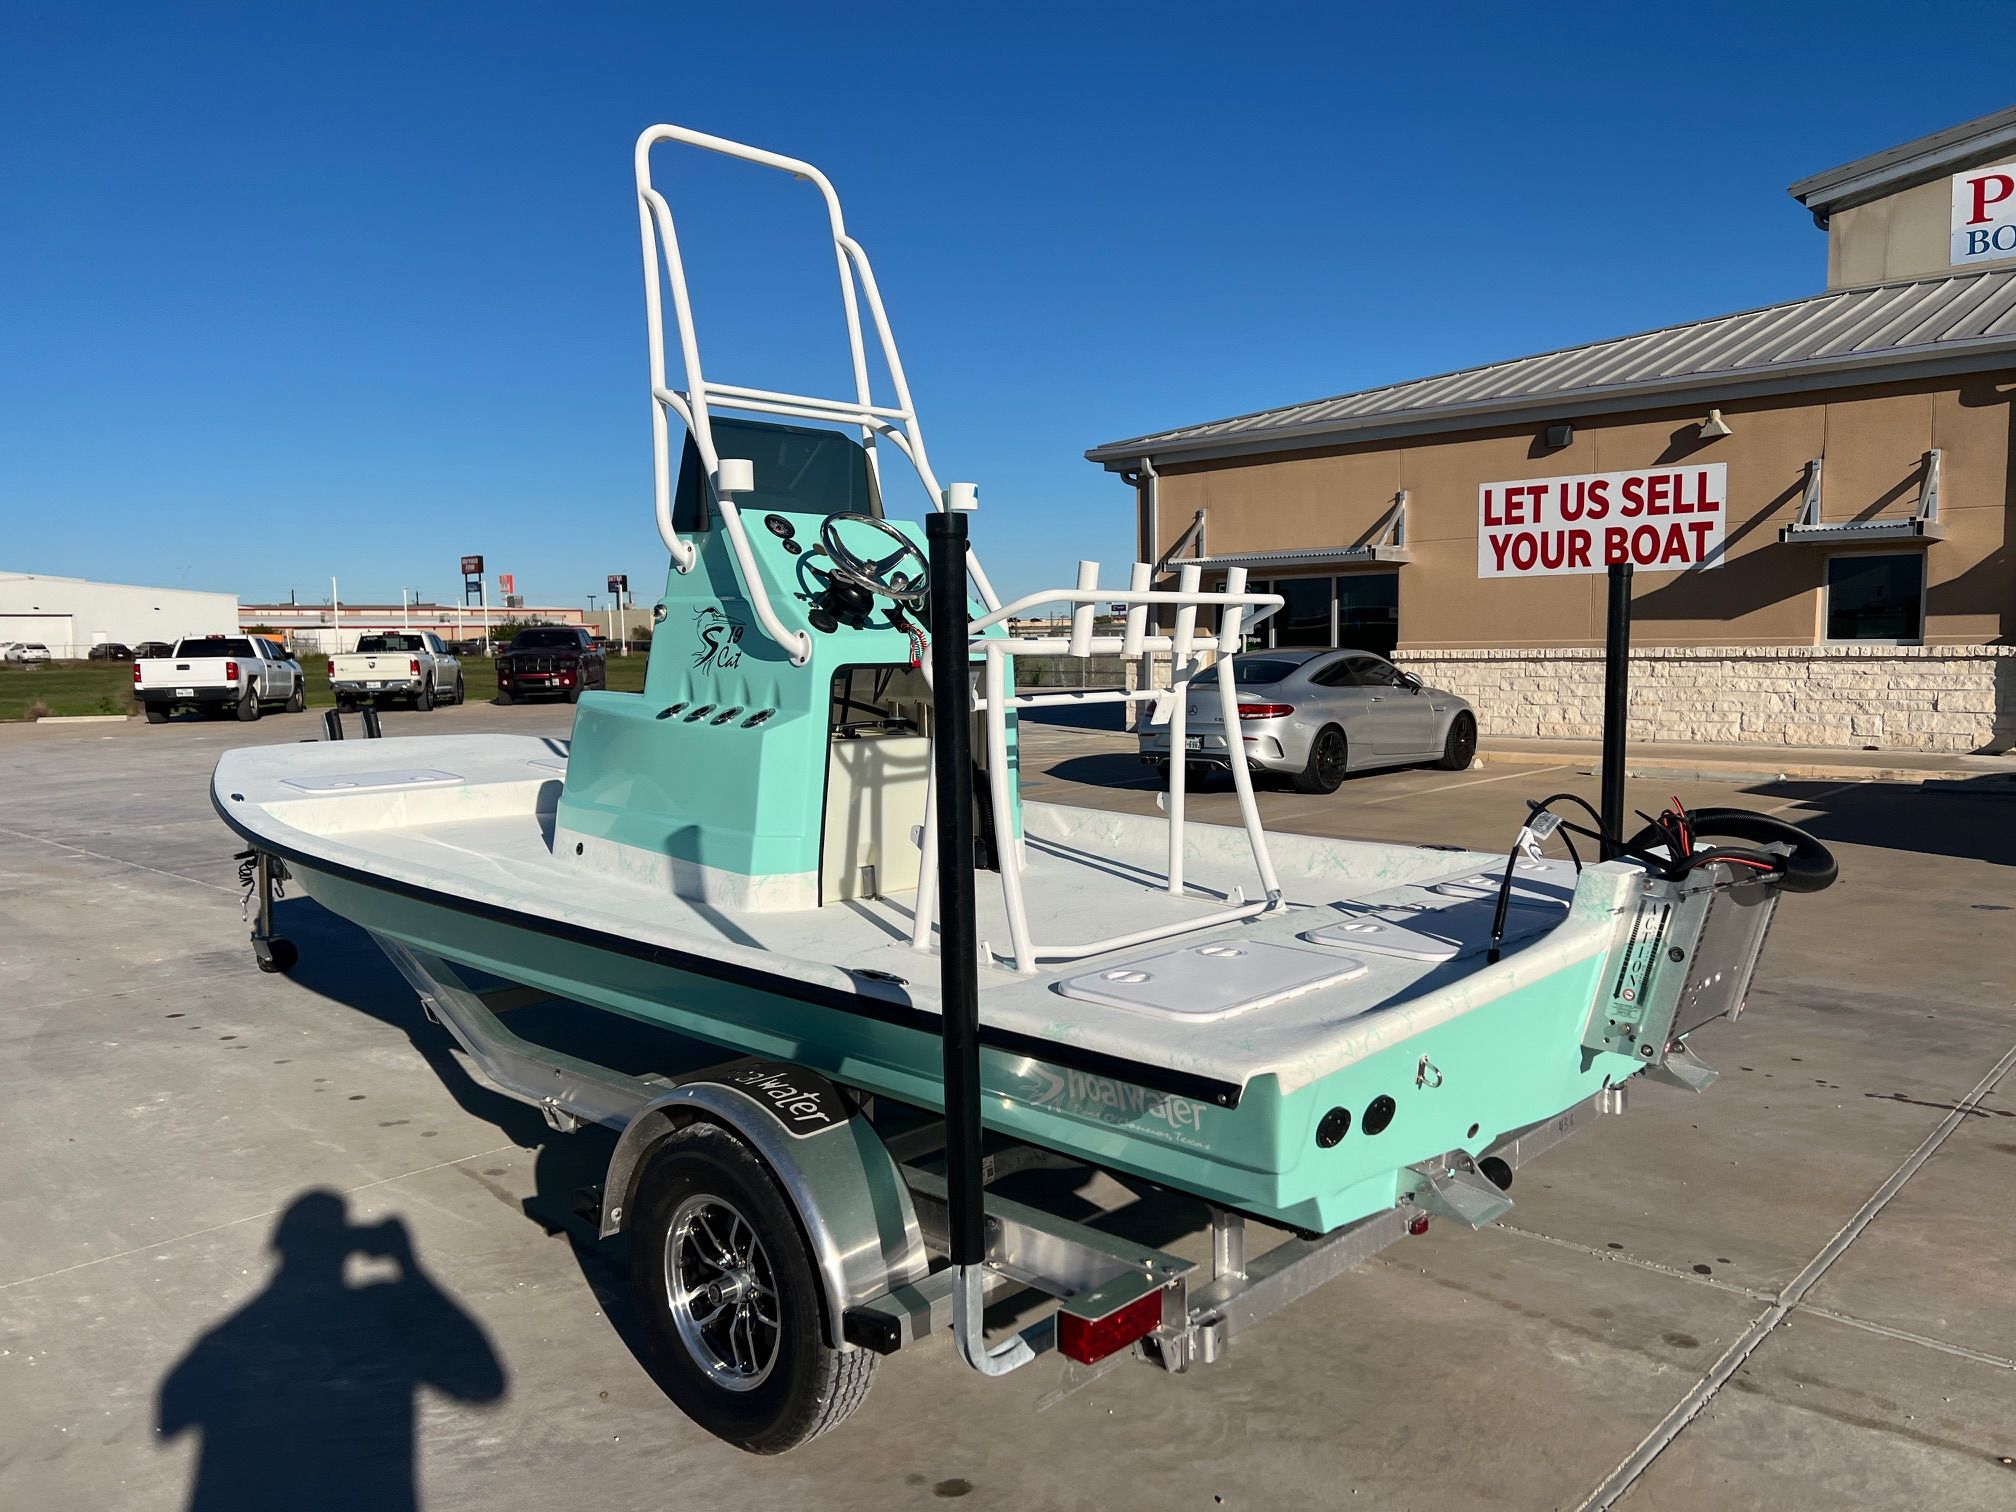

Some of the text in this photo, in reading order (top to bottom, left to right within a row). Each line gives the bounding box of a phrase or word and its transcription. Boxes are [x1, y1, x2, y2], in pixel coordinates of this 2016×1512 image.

[1484, 471, 1720, 527] LET US SELL
[1489, 521, 1713, 572] YOUR BOAT
[727, 625, 744, 644] 19
[717, 646, 742, 670] Cat
